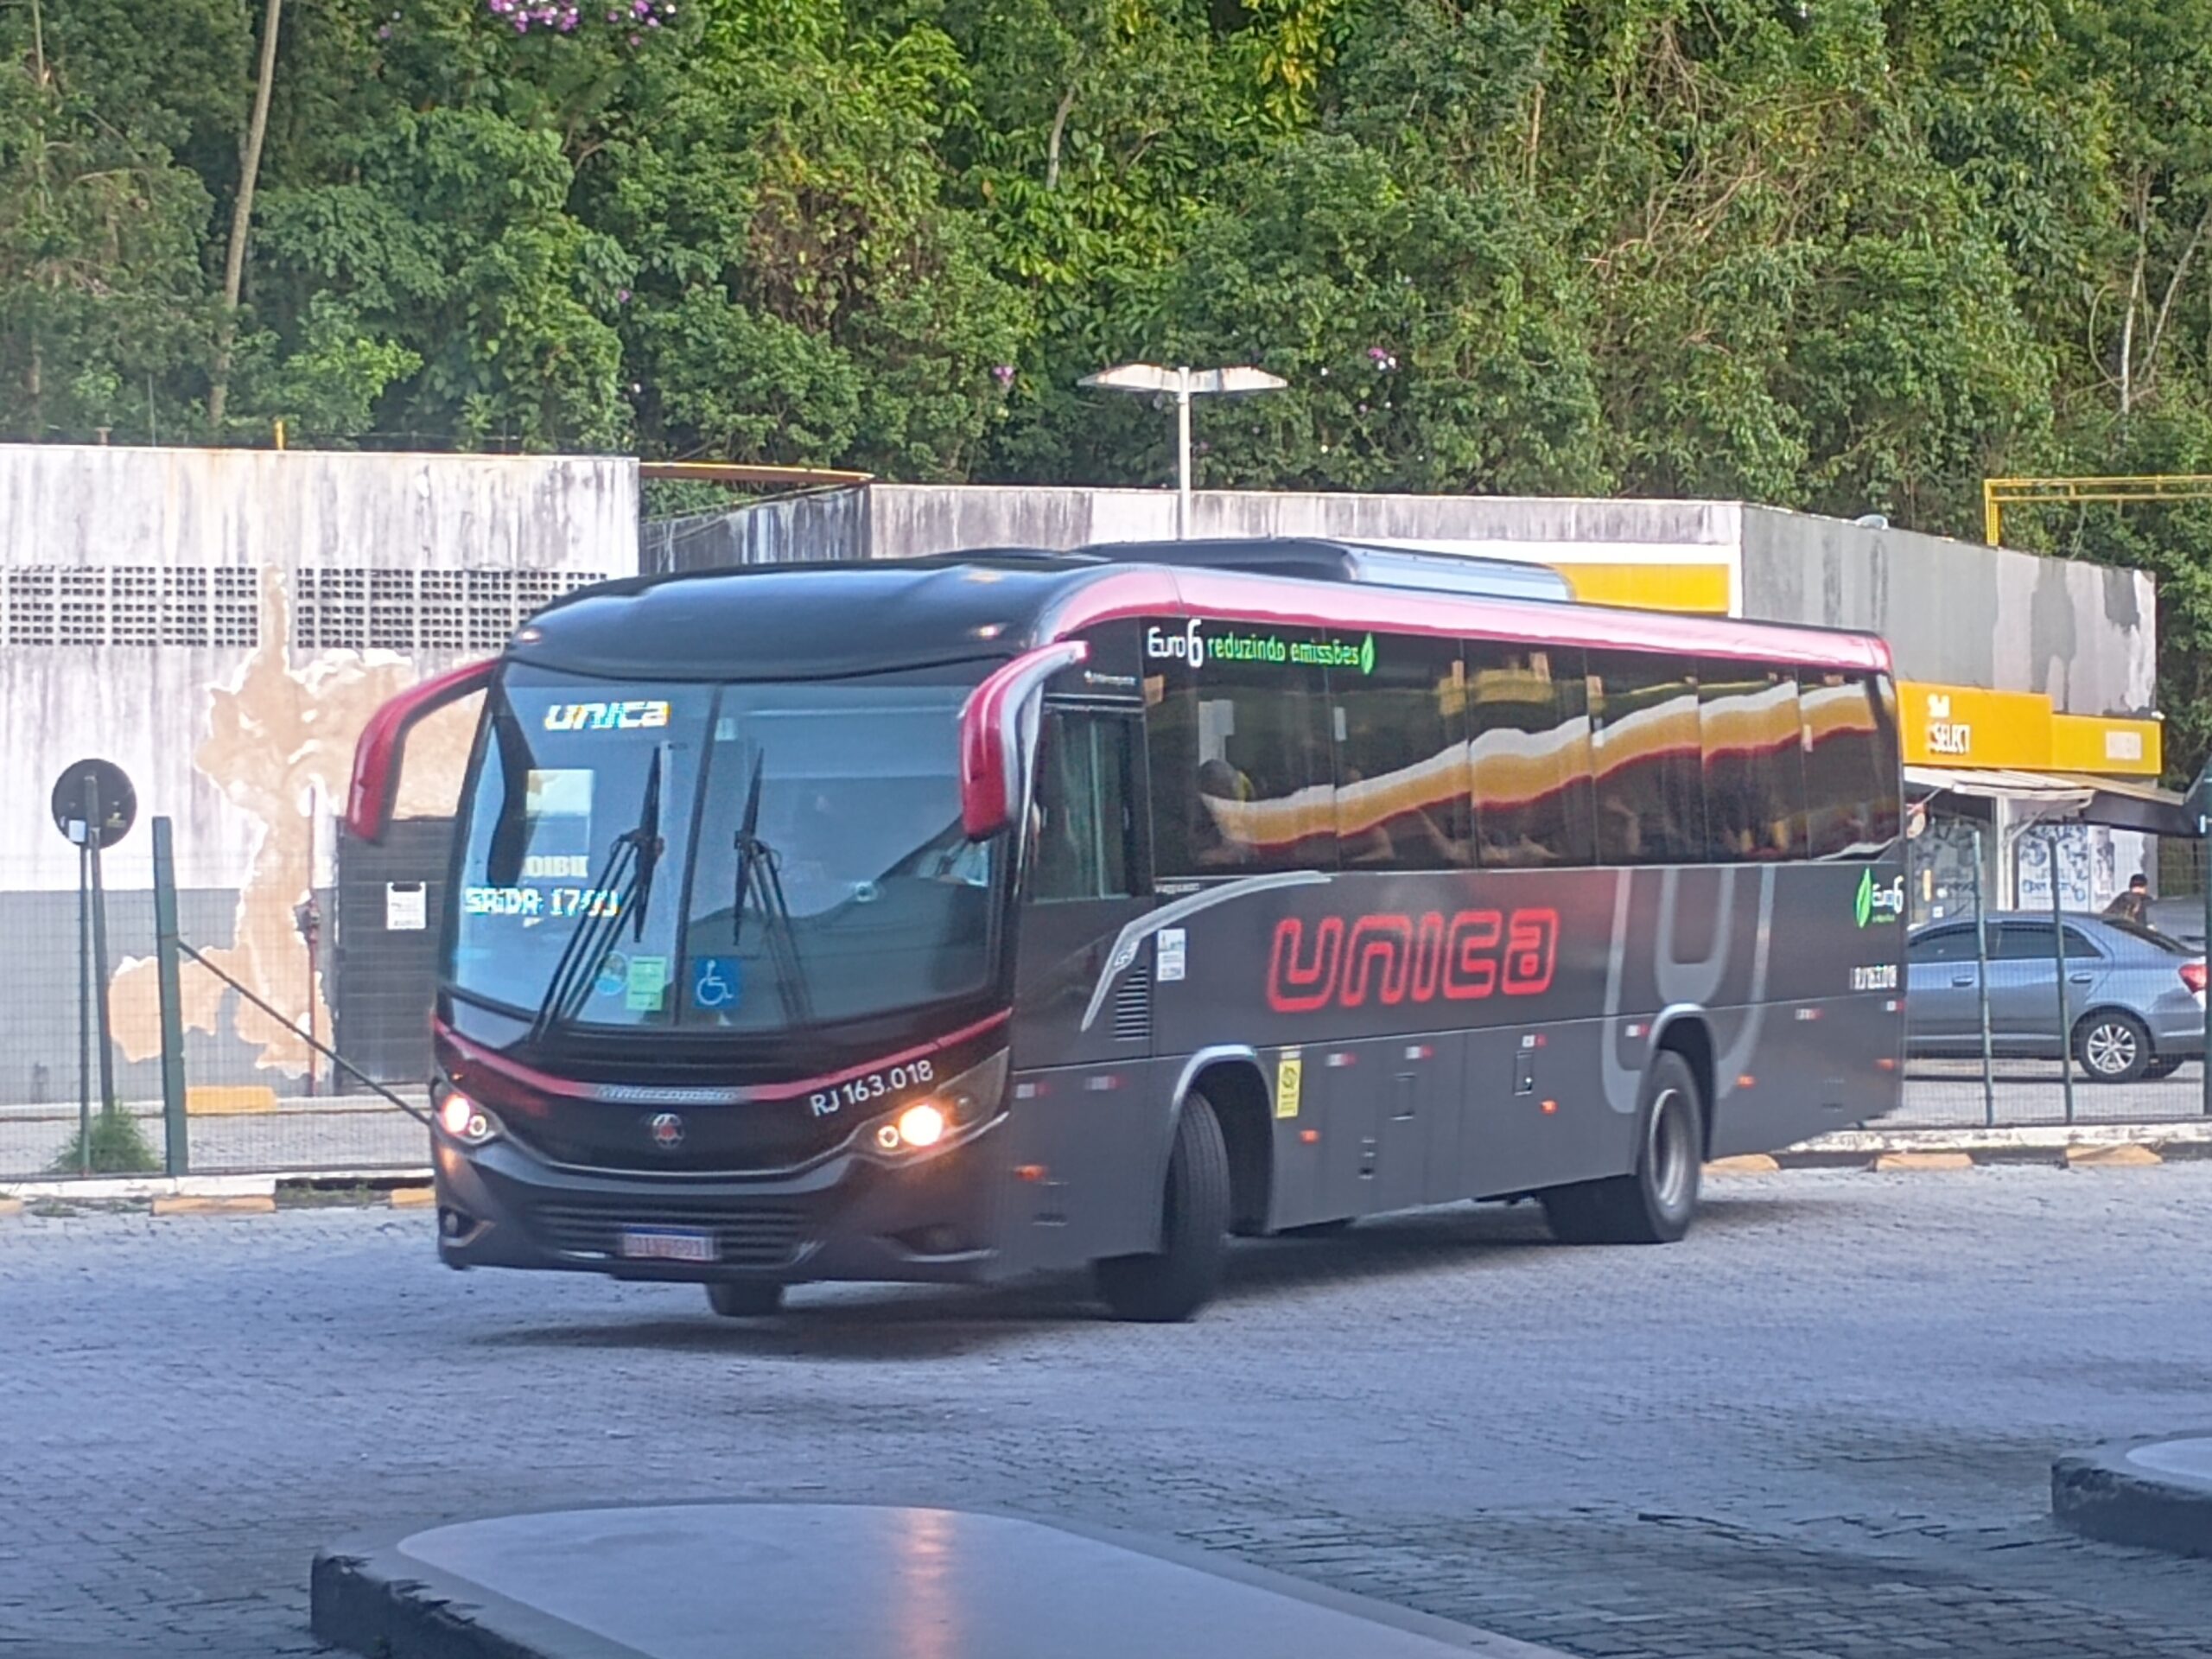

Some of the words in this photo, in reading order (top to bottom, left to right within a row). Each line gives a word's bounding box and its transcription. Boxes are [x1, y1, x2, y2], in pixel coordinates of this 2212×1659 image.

[1147, 619, 1203, 668] Euro6
[1208, 632, 1285, 662] reduzindo
[810, 1090, 840, 1116] RJ
[842, 1059, 934, 1105] 163.018
